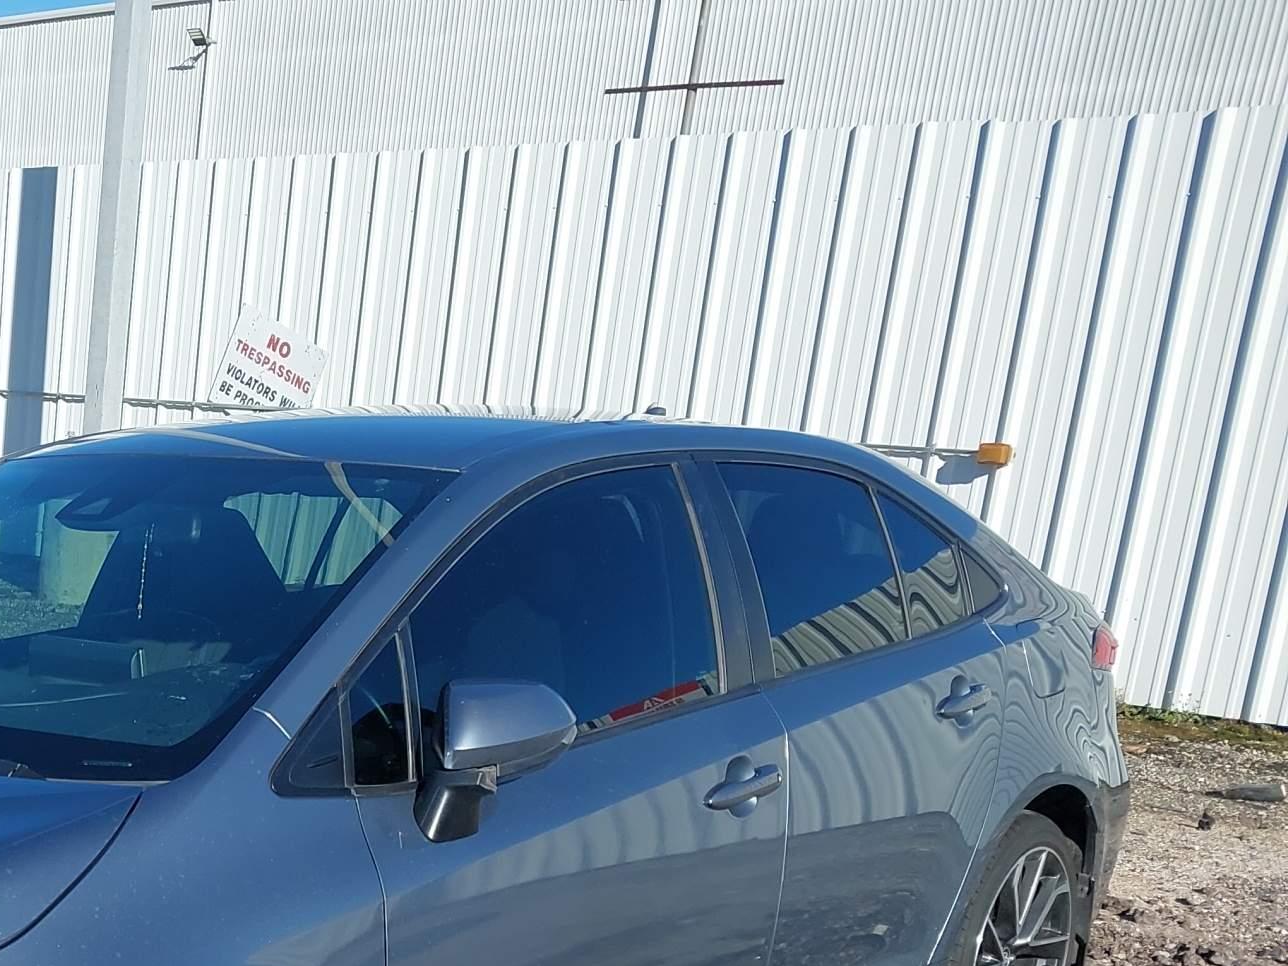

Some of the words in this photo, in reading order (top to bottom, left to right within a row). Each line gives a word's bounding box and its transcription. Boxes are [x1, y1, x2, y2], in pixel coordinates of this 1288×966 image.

[267, 334, 291, 358] NO
[226, 362, 277, 402] VIOLATORS
[235, 339, 311, 394] TRESPASSING
[219, 380, 233, 396] BE
